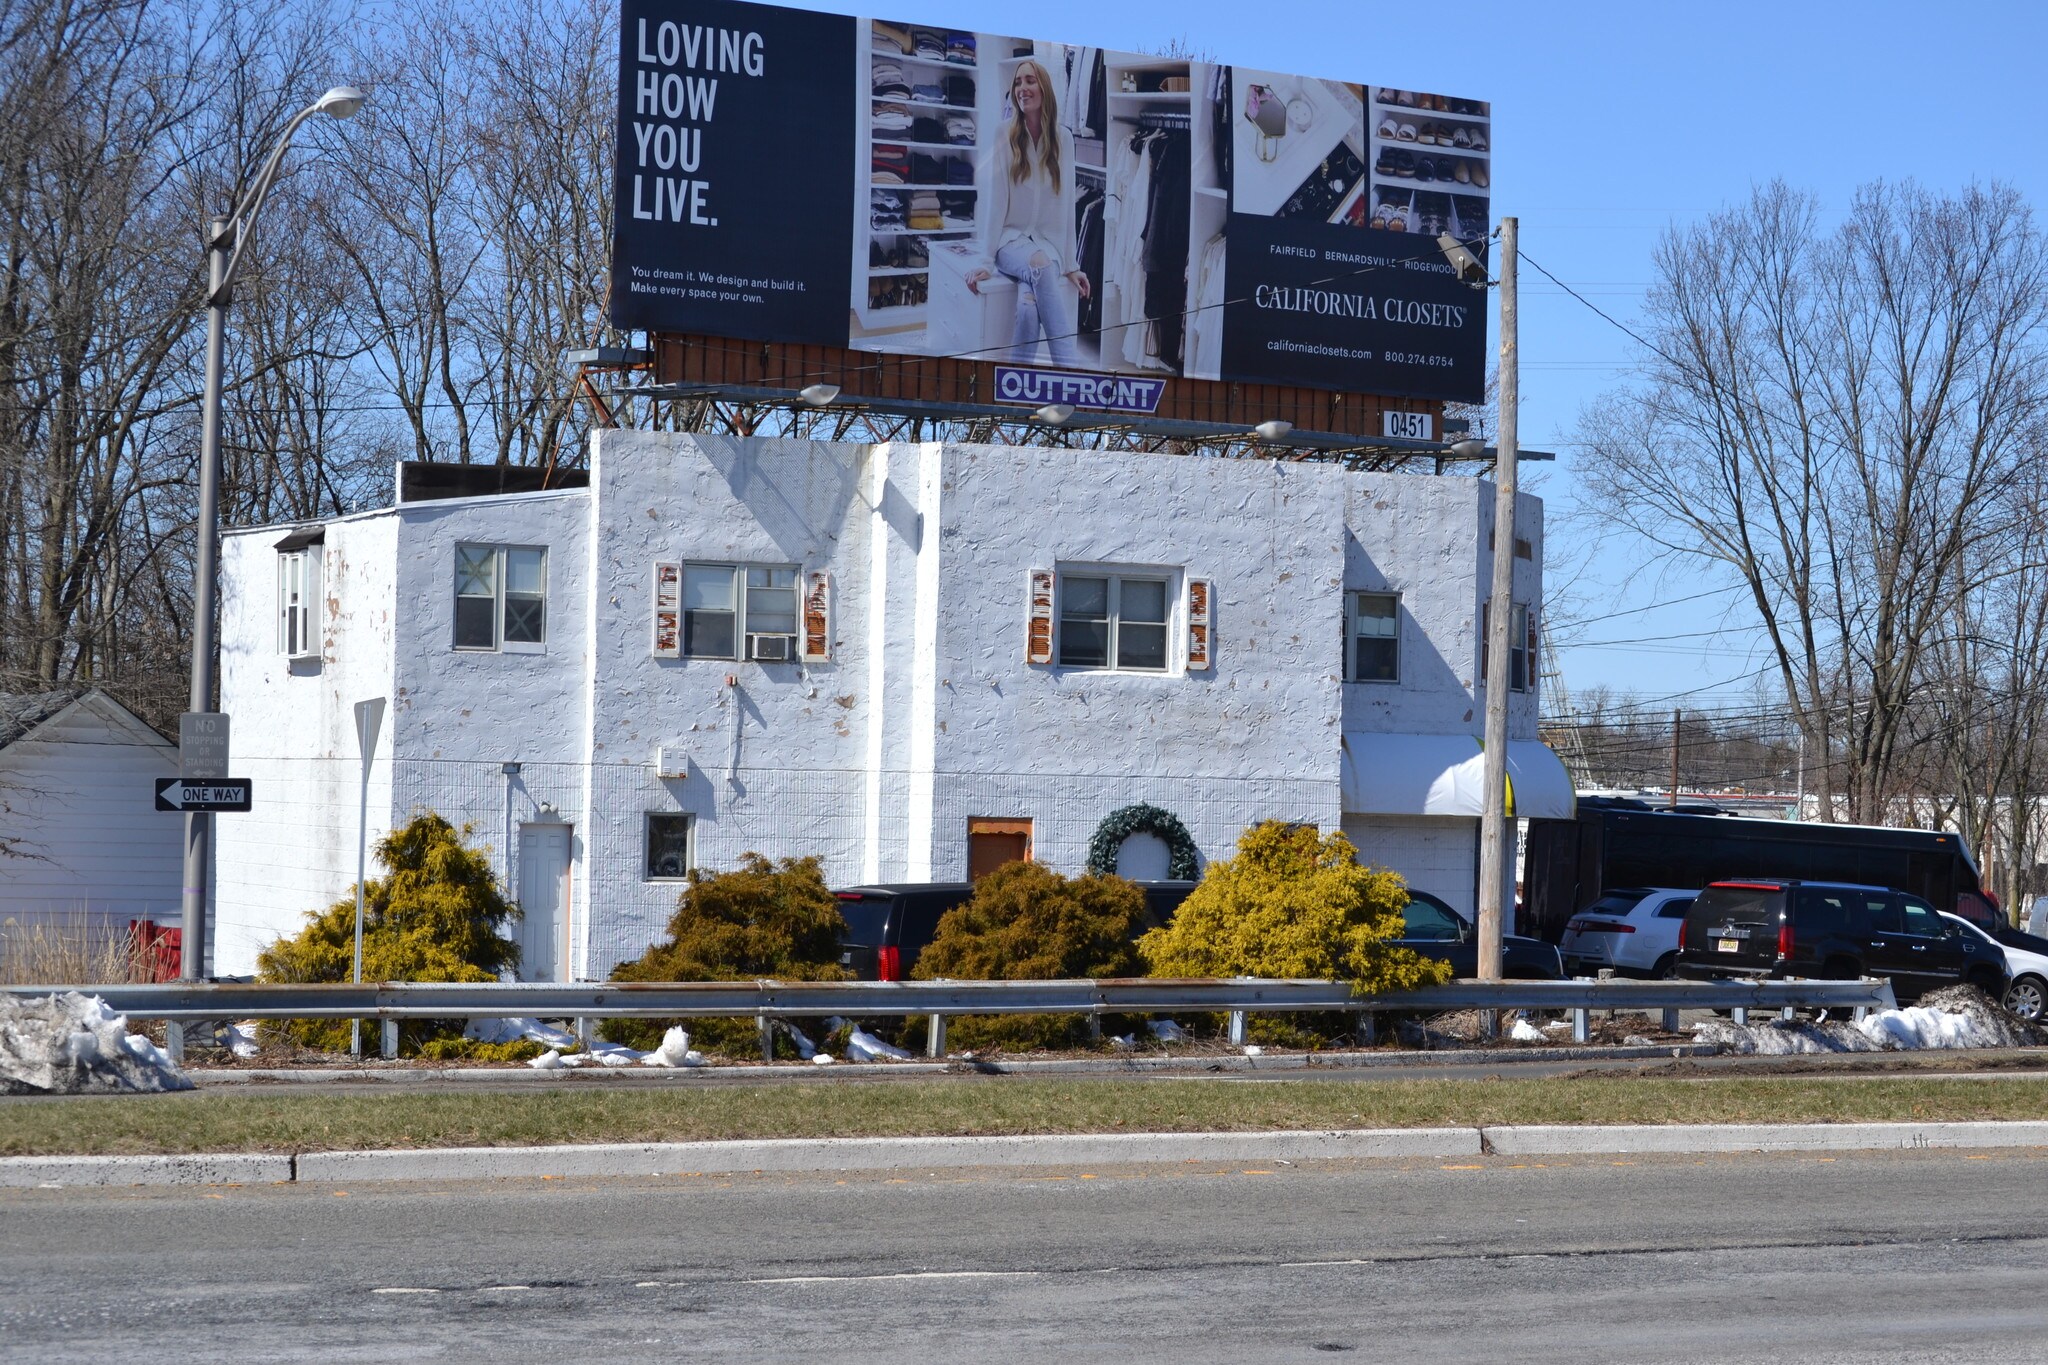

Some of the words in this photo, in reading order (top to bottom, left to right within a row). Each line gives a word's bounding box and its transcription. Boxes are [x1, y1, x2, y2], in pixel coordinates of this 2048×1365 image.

[638, 18, 764, 77] LOVING
[636, 70, 718, 122] HOW
[633, 121, 701, 173] YOU
[633, 174, 718, 227] LIVE.
[1270, 244, 1316, 258] FAIRFIELD
[1404, 260, 1457, 275] RIDGEWOOD
[630, 281, 658, 294] Make
[659, 286, 686, 298] every
[688, 288, 717, 299] space
[719, 290, 739, 302] your
[742, 293, 765, 304] own.
[632, 266, 650, 278] You
[653, 268, 683, 281] dream
[686, 271, 696, 282] it.
[699, 271, 714, 283] We
[716, 273, 749, 288] design
[751, 278, 768, 289] and
[771, 279, 794, 291] build
[797, 281, 807, 292] it.
[1255, 284, 1377, 320] CALIFORNIA
[1384, 298, 1464, 328] CLOSETS
[1267, 339, 1372, 360] californiaclosets.com
[1385, 351, 1453, 367] 800.274.6754
[1001, 371, 1155, 408] OUTFRONT
[1391, 413, 1424, 438] 0451
[195, 720, 216, 733] NO
[186, 736, 224, 745] STOPPING
[200, 747, 210, 756] OR
[185, 758, 223, 767] STANDING
[183, 788, 209, 801] ONE
[213, 788, 241, 801] WAY
